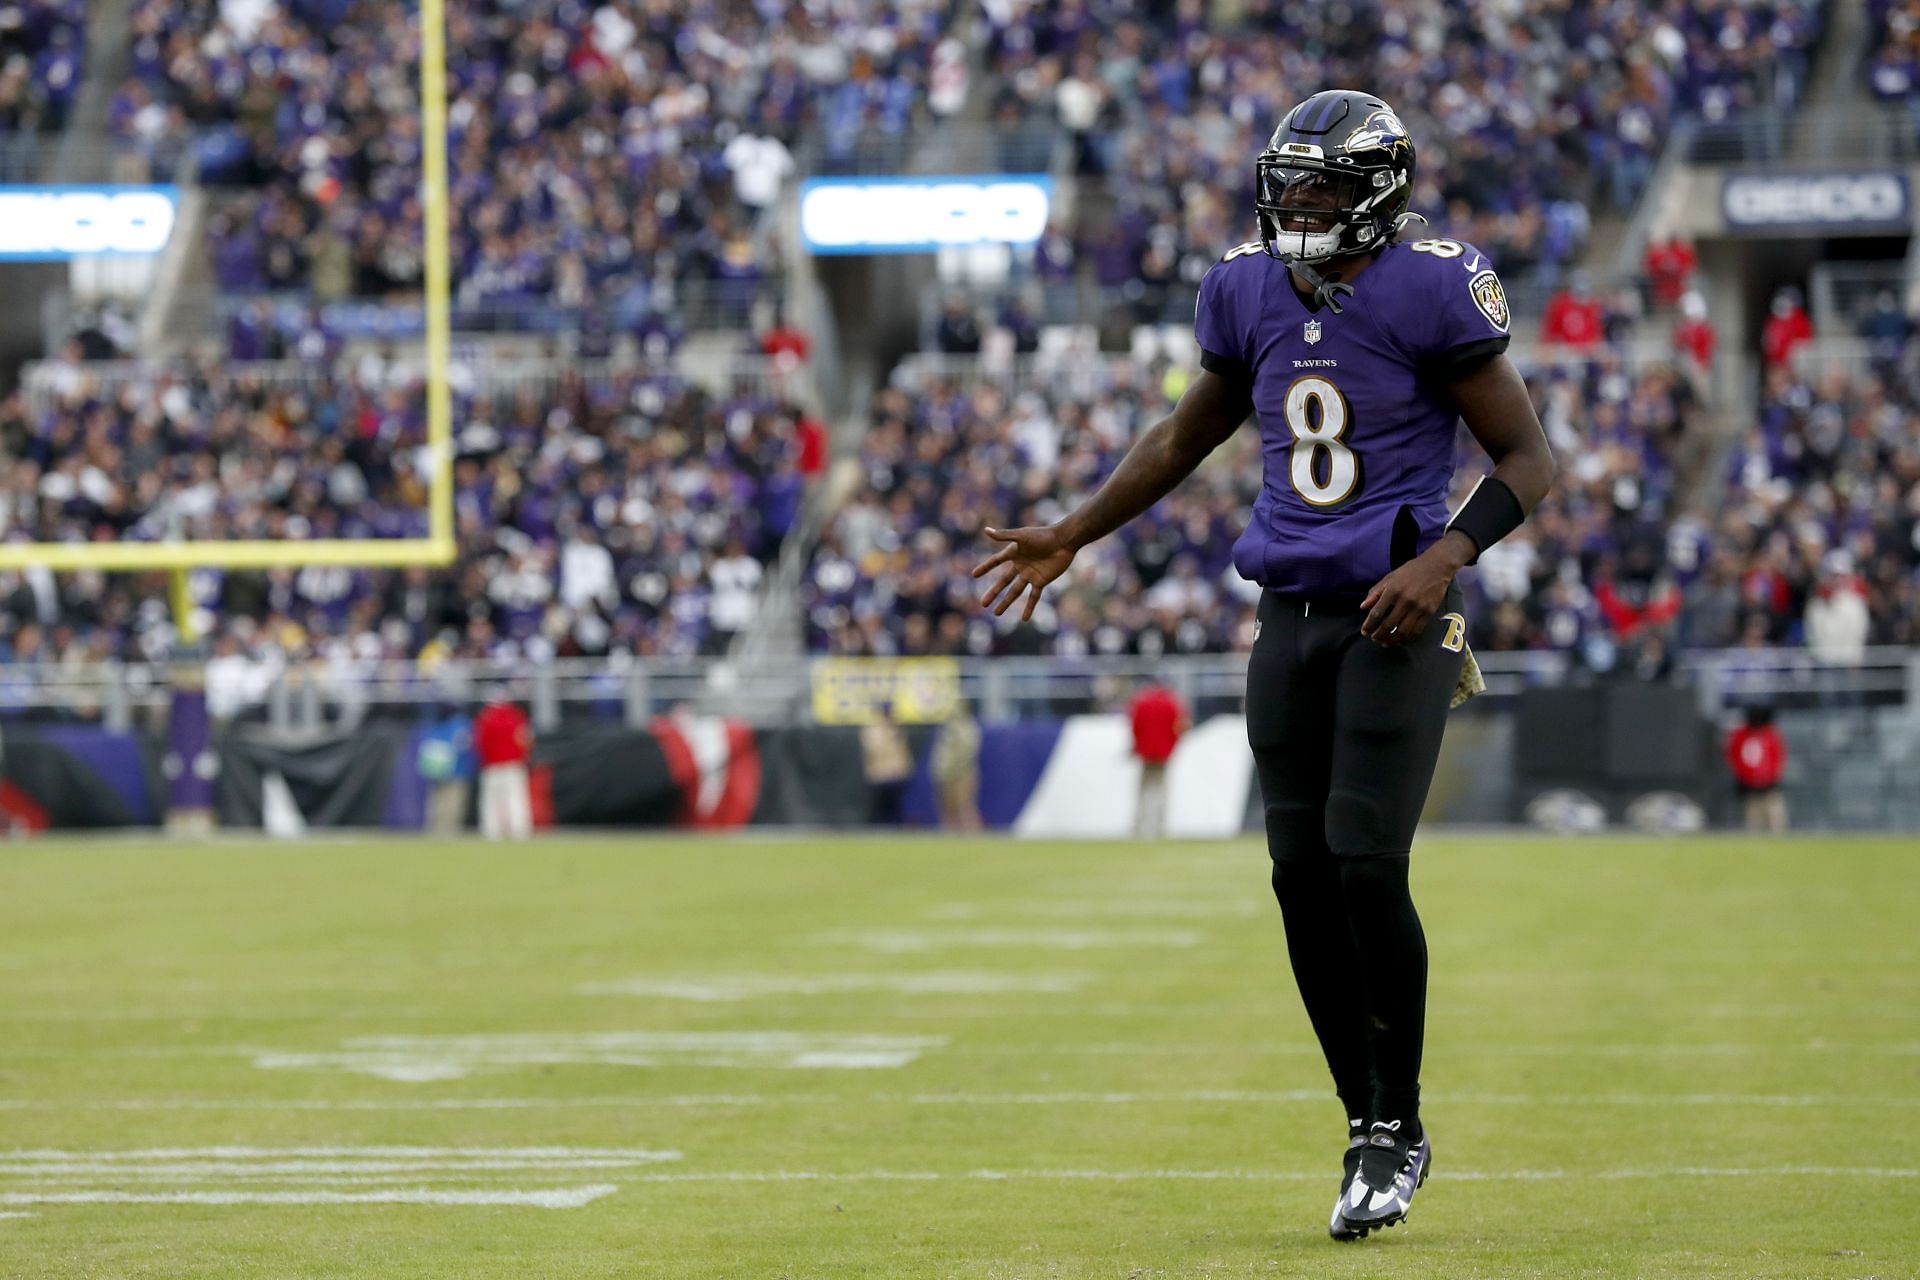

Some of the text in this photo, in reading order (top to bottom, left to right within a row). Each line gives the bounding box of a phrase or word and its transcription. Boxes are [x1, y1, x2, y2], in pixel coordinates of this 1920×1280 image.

[1725, 174, 1904, 224] GEICO
[1411, 239, 1465, 258] 8
[1292, 359, 1338, 368] RAVENS
[1283, 374, 1359, 506] 8
[1440, 612, 1466, 653] B
